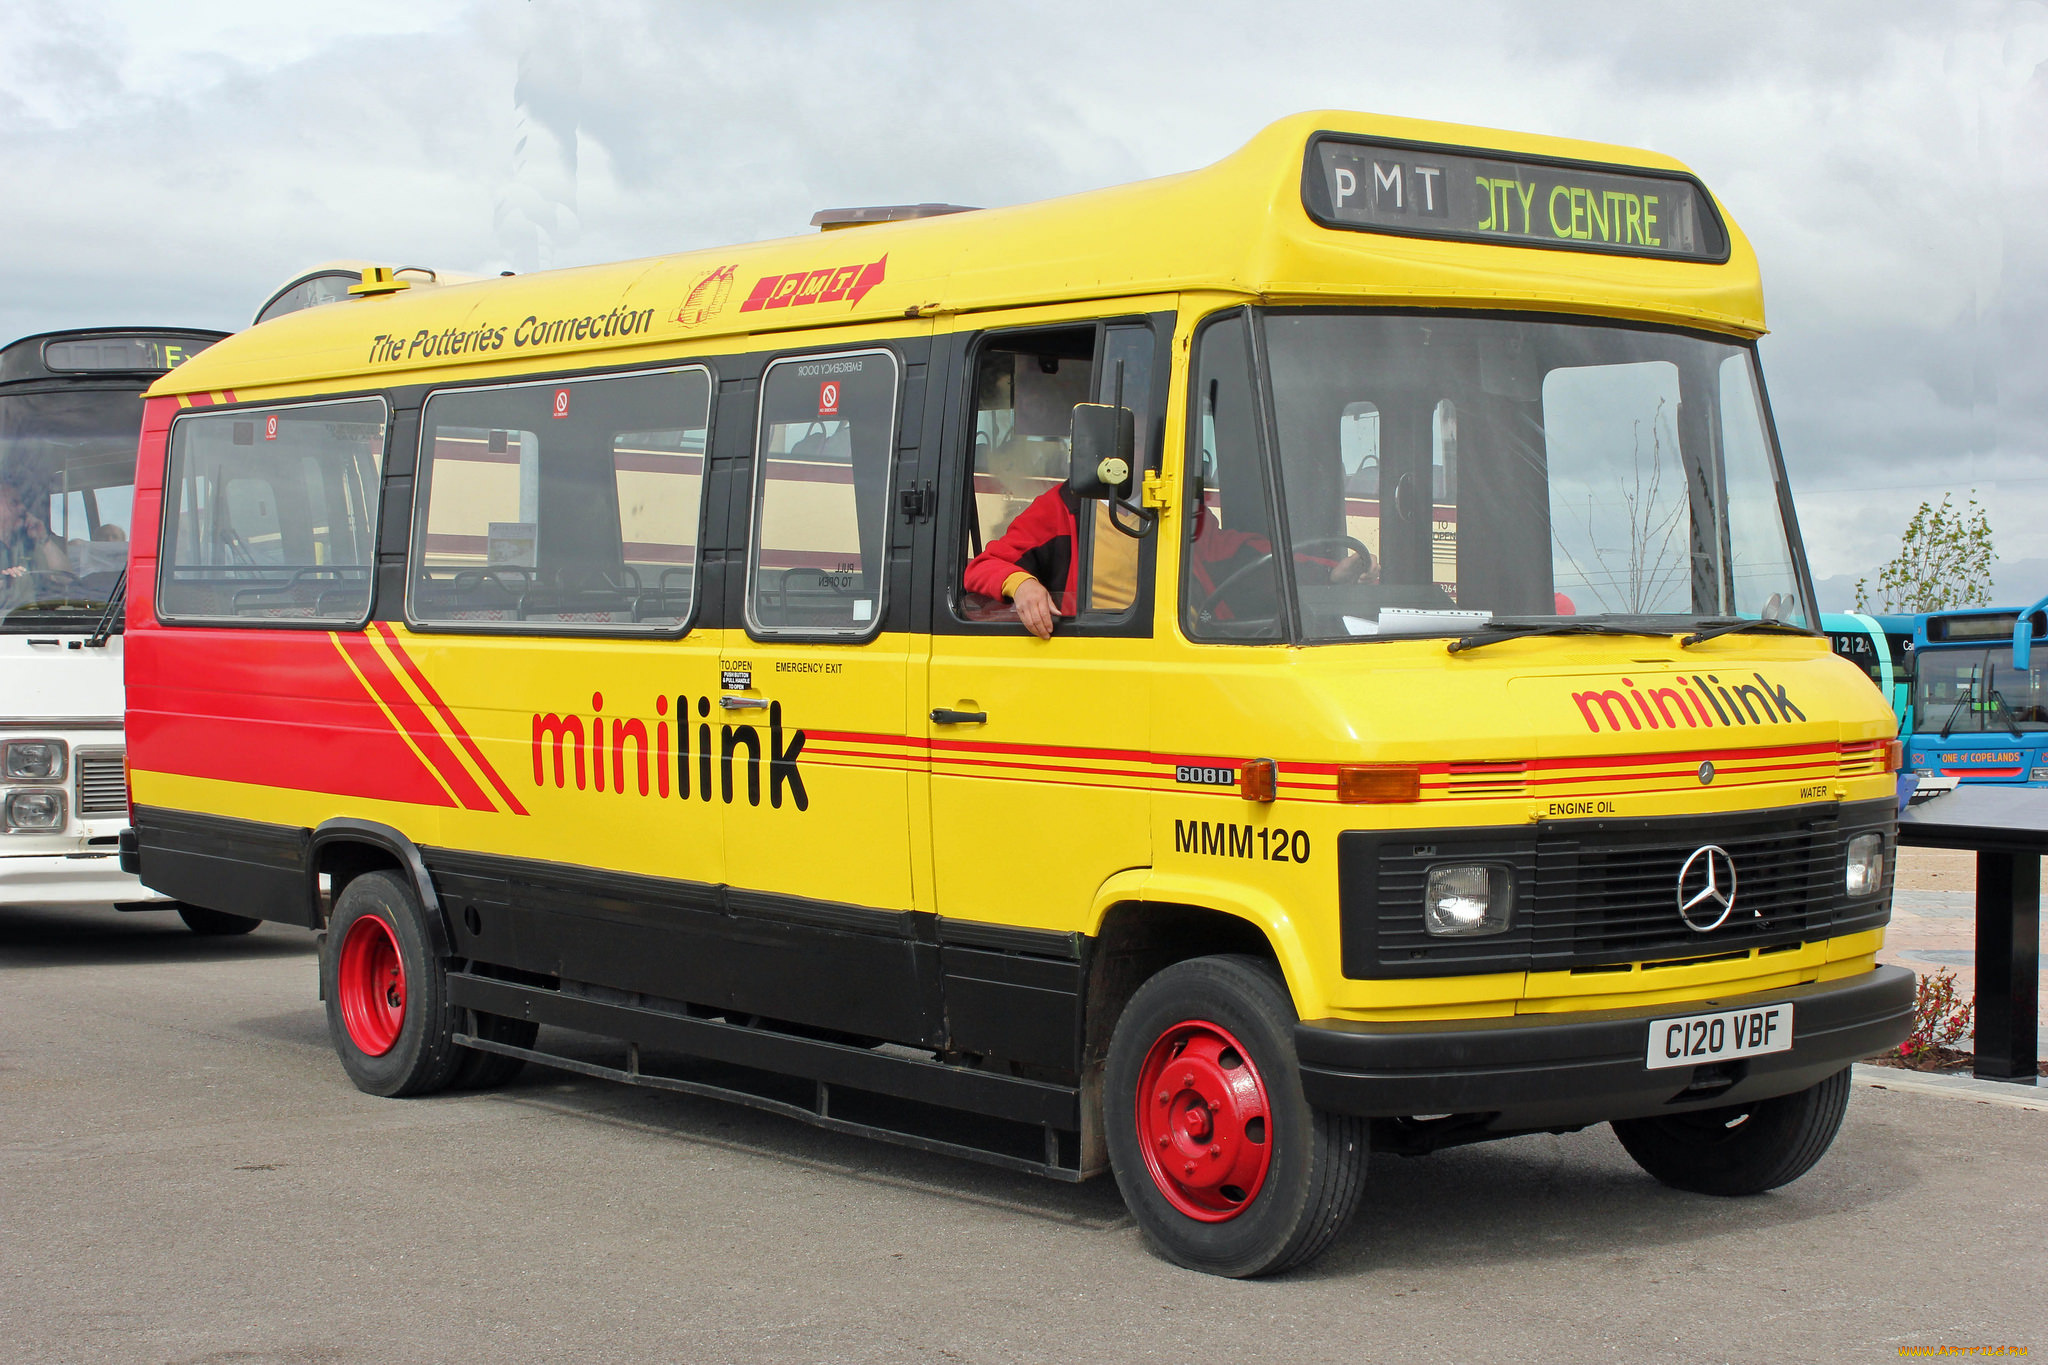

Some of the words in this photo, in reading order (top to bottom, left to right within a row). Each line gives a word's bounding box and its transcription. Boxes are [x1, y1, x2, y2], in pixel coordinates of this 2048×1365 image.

[1549, 185, 1661, 247] CENTRE
[775, 272, 854, 300] PMT
[369, 334, 406, 363] The
[408, 322, 508, 359] Potteries
[514, 304, 655, 347] Connection
[1436, 520, 1448, 530] TO
[732, 660, 753, 671] OPEN
[776, 662, 824, 673] EMERGENCY
[825, 663, 843, 674] EXIT
[1571, 672, 1807, 733] minilink
[532, 691, 809, 812] minilink
[1942, 753, 1958, 763] ONE
[1960, 753, 1968, 763] of
[1970, 752, 2020, 763] COPELANDS
[1176, 766, 1232, 784] 608D
[1800, 785, 1828, 799] WATER
[1549, 802, 1594, 816] ENGINE
[1597, 802, 1616, 813] OIL
[1175, 819, 1311, 864] MMM120
[1665, 1018, 1725, 1059] C120
[1733, 1010, 1779, 1050] VBF
